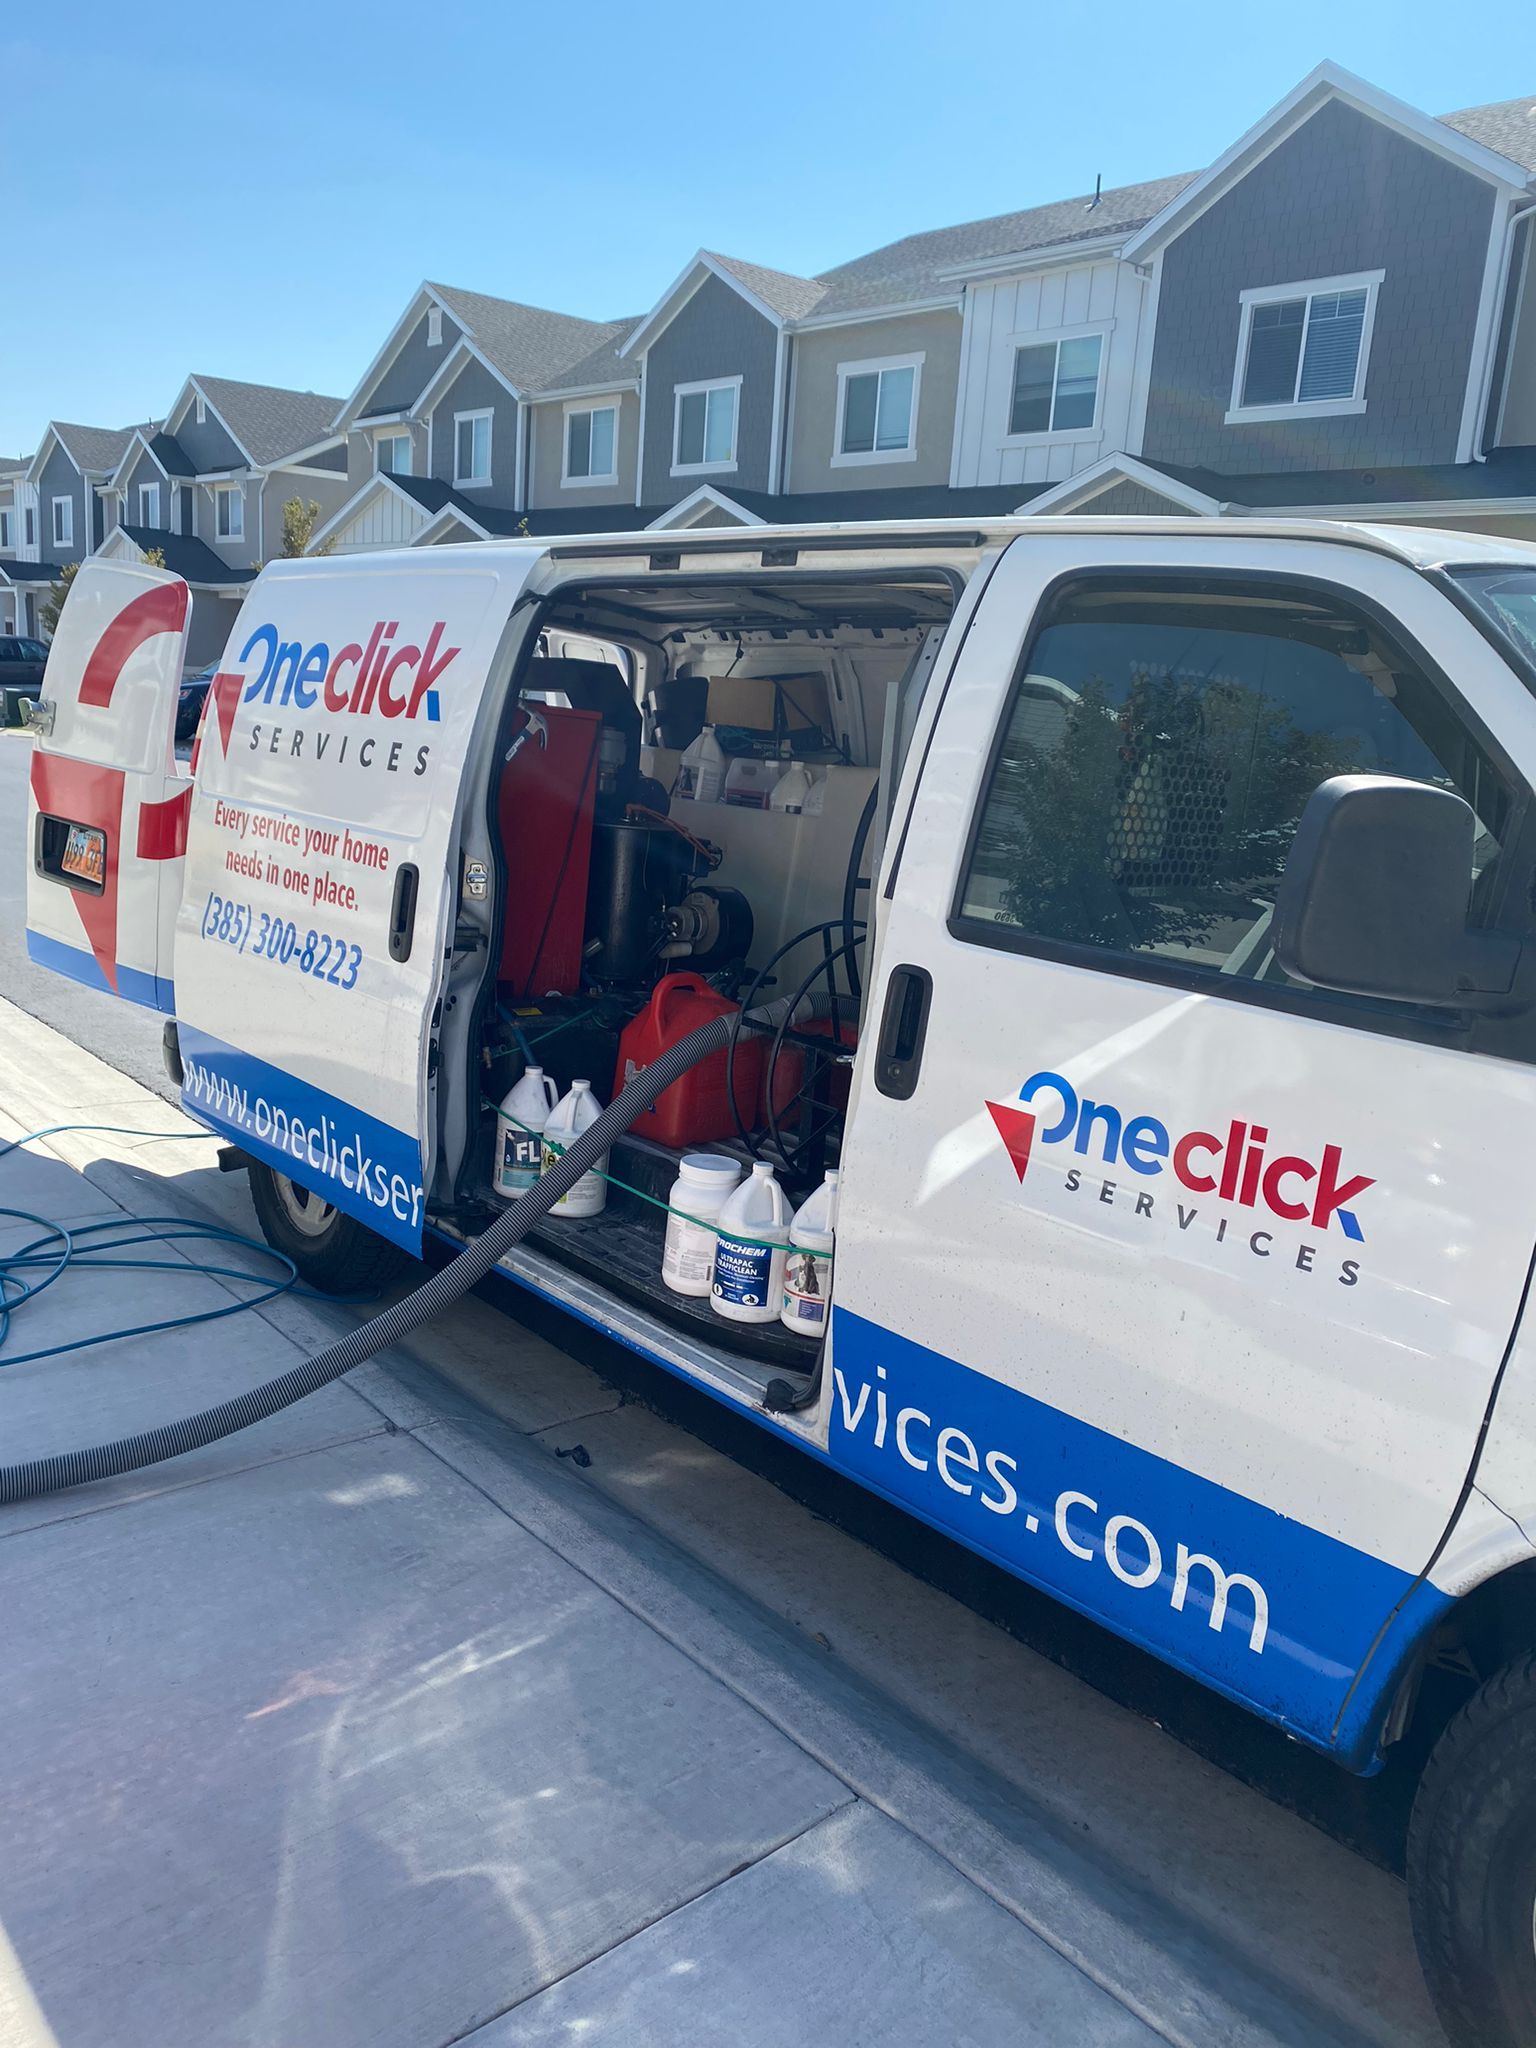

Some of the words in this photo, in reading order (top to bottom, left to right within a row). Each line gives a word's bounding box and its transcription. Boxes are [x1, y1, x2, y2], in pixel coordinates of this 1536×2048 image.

[249, 724, 431, 776] SERVICES
[215, 800, 249, 839] Every
[251, 814, 300, 847] service
[302, 828, 339, 857] your
[342, 828, 389, 871] home
[225, 849, 263, 881] needs
[266, 854, 279, 886] in
[283, 867, 309, 896] one
[312, 871, 359, 912] place.
[201, 891, 252, 954] (385)
[252, 912, 363, 991] 300-8223
[181, 1055, 424, 1228] www.oneclickser
[720, 1252, 753, 1268] ULTRAPAC
[1065, 1169, 1361, 1286] SERVICES
[834, 1365, 1269, 1655] vices.com
